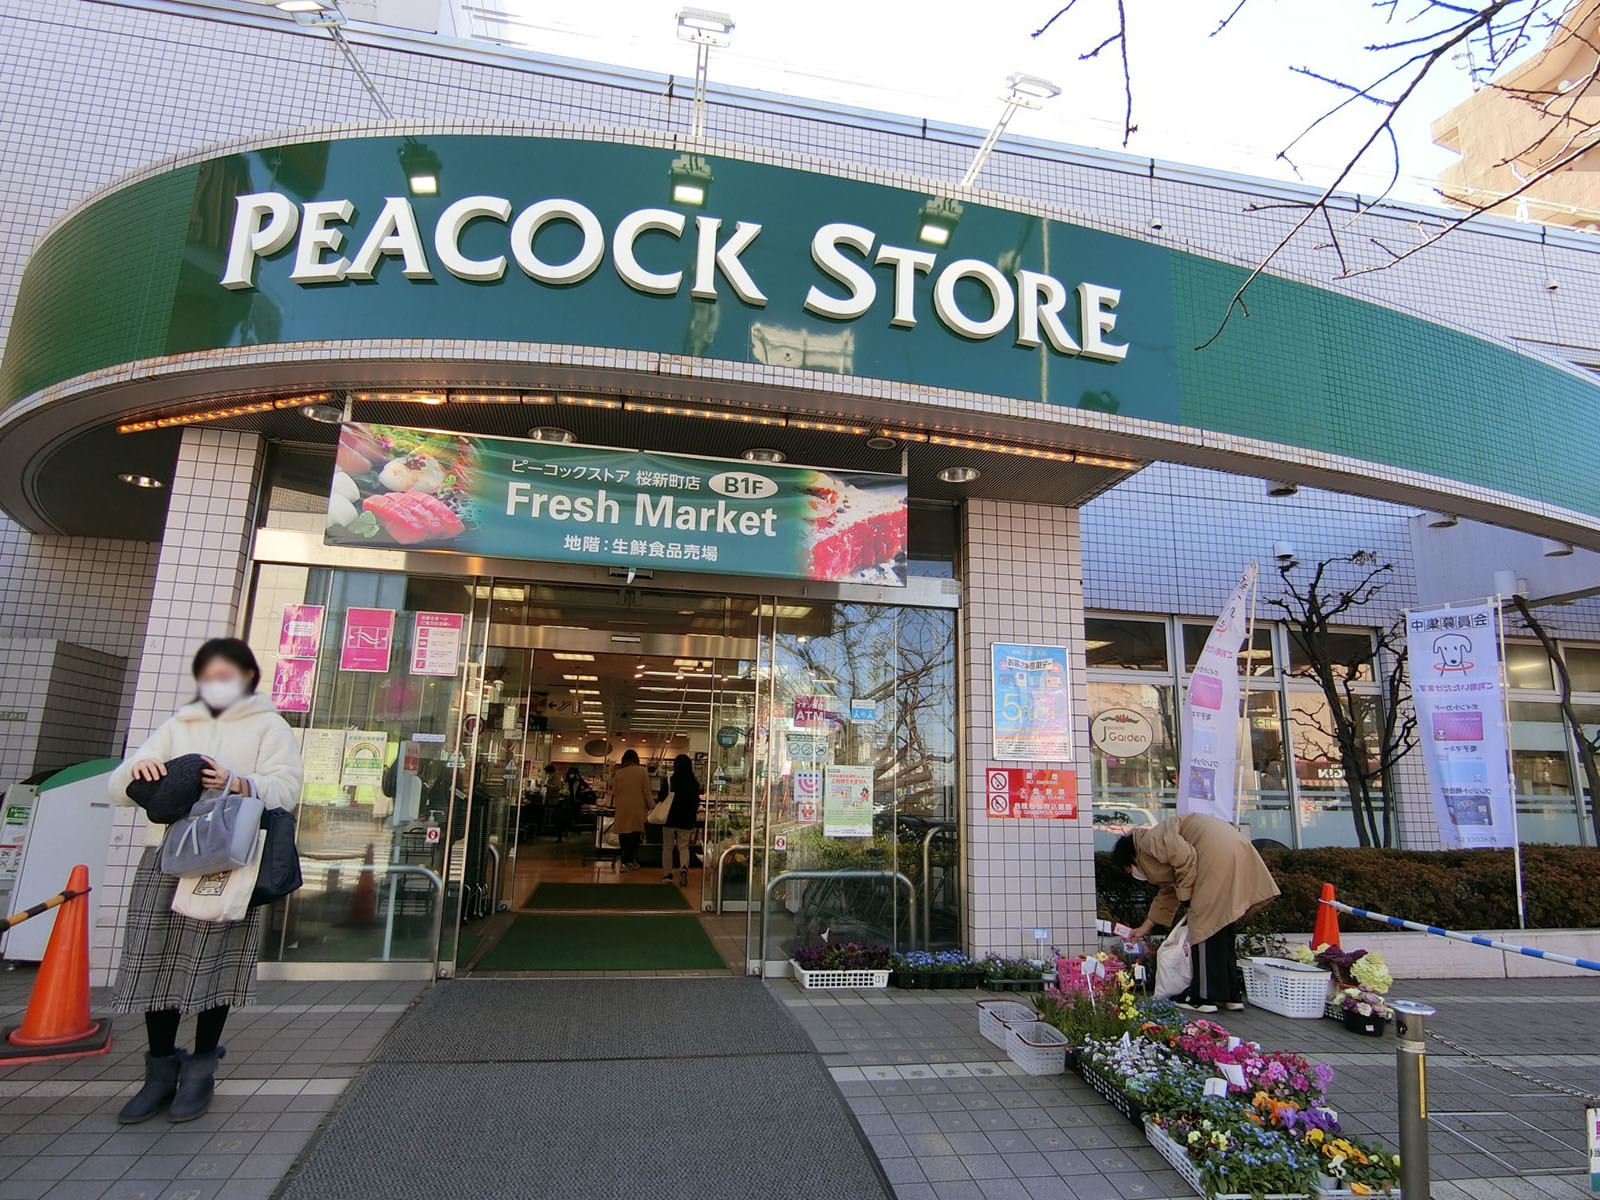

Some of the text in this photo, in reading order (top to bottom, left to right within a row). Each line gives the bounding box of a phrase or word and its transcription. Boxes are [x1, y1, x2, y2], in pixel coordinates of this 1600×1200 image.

[219, 191, 1130, 363] PEACOCK STORE
[511, 459, 764, 494] ピーコックストア 桜新町店 B1F
[506, 481, 777, 537] Fresh Market
[796, 711, 825, 722] ATM
[1109, 732, 1147, 743] Garden
